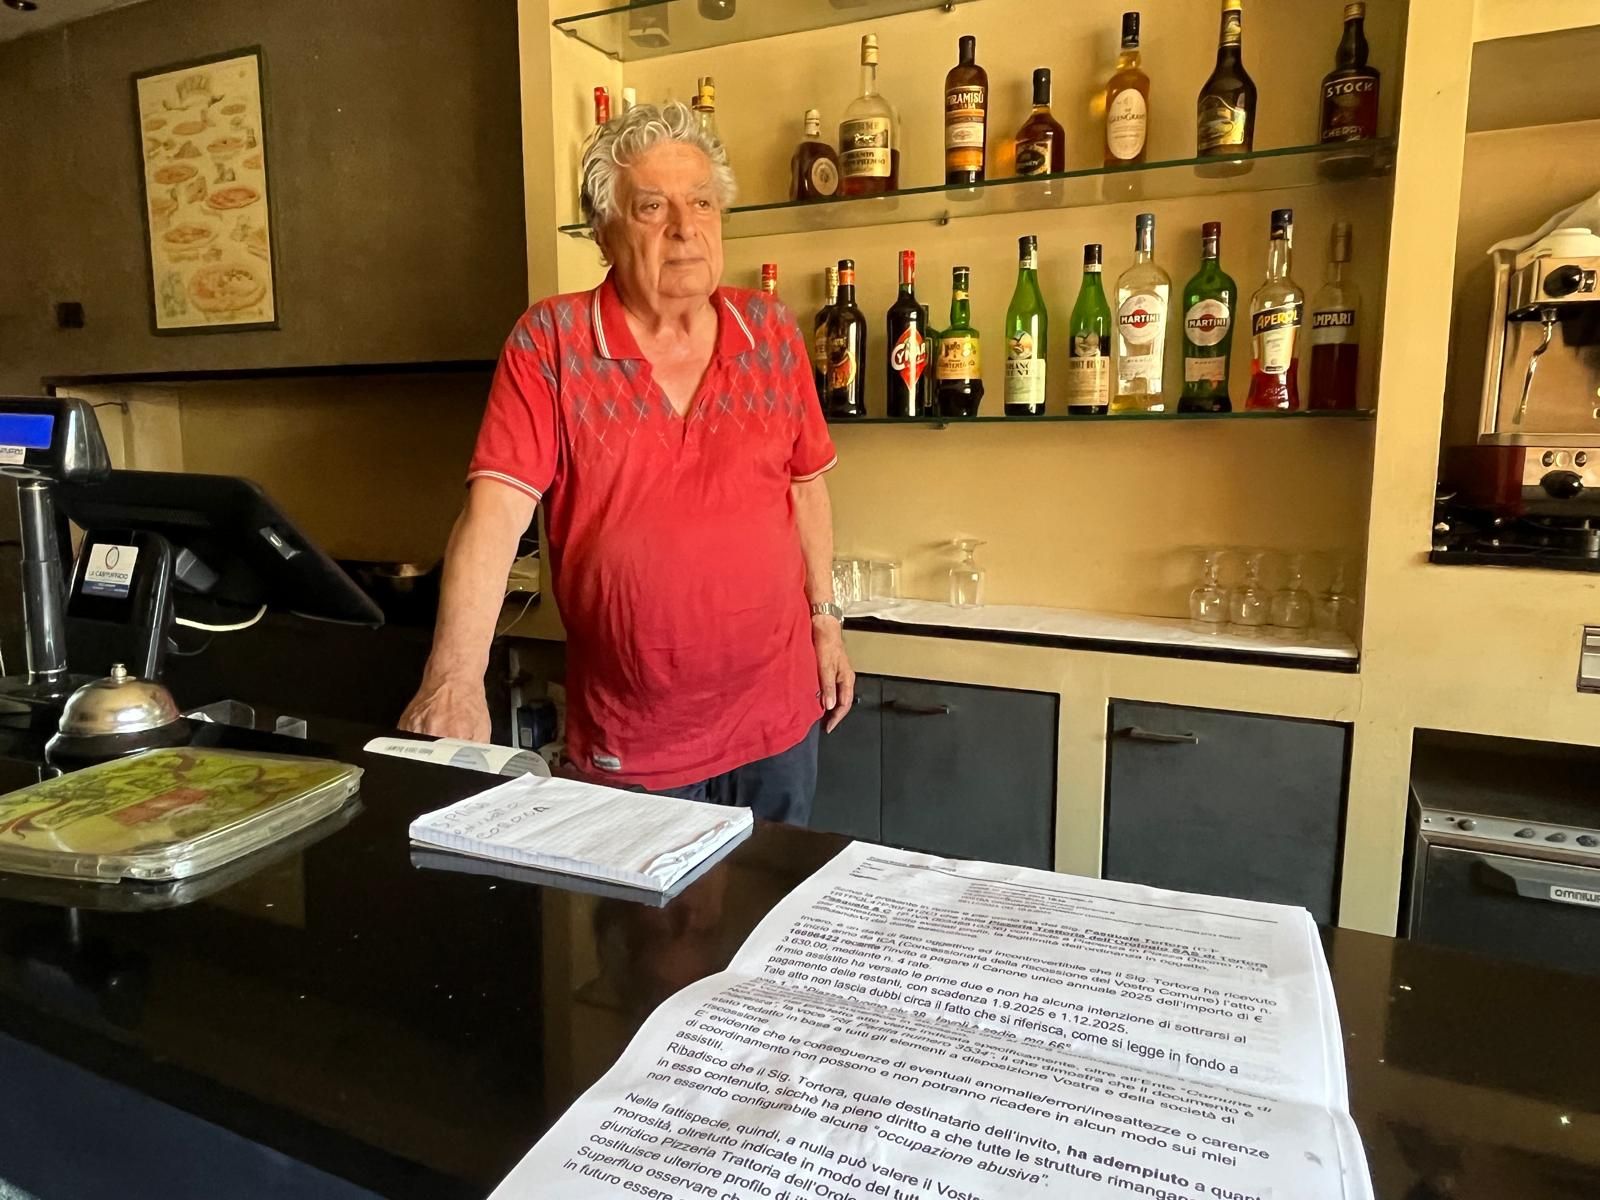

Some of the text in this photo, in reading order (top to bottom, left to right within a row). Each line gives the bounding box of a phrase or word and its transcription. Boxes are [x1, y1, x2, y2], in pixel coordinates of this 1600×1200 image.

[1326, 82, 1374, 98] STOCK
[1120, 313, 1160, 325] MARTINI
[1188, 318, 1227, 328] MARTINI
[1255, 309, 1298, 331] APEROL
[832, 946, 881, 960] mediante
[763, 965, 785, 976] Tale
[787, 971, 808, 981] atto
[810, 976, 831, 986] non
[833, 979, 866, 994] lascia
[869, 987, 901, 1001] dubbi
[904, 995, 931, 1008] circa
[934, 1000, 940, 1010] il
[943, 1002, 970, 1016] fatto
[973, 1009, 996, 1021] che
[999, 1014, 1010, 1025] si
[1013, 1017, 1067, 1039] riferisca,
[1071, 1030, 1108, 1046] come
[1111, 1038, 1123, 1049] si
[1126, 1040, 1165, 1059] legge
[1169, 1048, 1180, 1063] in
[1185, 1053, 1225, 1072] fondo
[1229, 1065, 1238, 1074] a
[767, 956, 827, 972] pagamento
[830, 966, 856, 978] delle
[906, 983, 927, 993] con
[930, 987, 987, 1005] scadenza
[992, 998, 1044, 1016] 1.9.2025
[1048, 1011, 1056, 1019] e
[1061, 1013, 1128, 1034] 1.12.2025.
[783, 947, 803, 955] mio
[804, 951, 848, 964] assistito
[850, 958, 865, 967] ha
[868, 963, 908, 976] versato
[911, 970, 922, 979] le
[924, 974, 957, 986] prime
[960, 981, 983, 991] due
[996, 988, 1019, 998] non
[1022, 992, 1039, 1002] ha
[1041, 998, 1084, 1012] alcuna
[1087, 1005, 1154, 1026] intenzione
[1158, 1020, 1170, 1029] di
[1174, 1024, 1230, 1041] sottrarsi
[1234, 1035, 1246, 1044] al
[675, 1031, 723, 1051] assistiti.
[646, 1072, 671, 1082] non
[673, 1078, 728, 1098] essendo
[731, 1094, 817, 1119] configurabile
[820, 1115, 868, 1133] alcuna
[666, 1041, 727, 1067] Ribadisco
[730, 1062, 754, 1073] che
[756, 1067, 765, 1076] il
[766, 1069, 791, 1083] Sig.
[798, 1075, 847, 1099] Tortora,
[852, 1092, 891, 1106] quale
[895, 1100, 980, 1132] destinatario
[1066, 1145, 1087, 1160] ha
[1092, 1155, 1189, 1187] adempiuto
[1194, 1182, 1205, 1192] a
[684, 1019, 697, 1027] di
[699, 1024, 790, 1055] coordinamento
[792, 1048, 816, 1061] non
[818, 1056, 877, 1073] possono
[892, 1073, 919, 1084] non
[921, 1080, 986, 1101] potranno
[990, 1096, 1050, 1118] ricadere
[1055, 1111, 1068, 1123] in
[1073, 1118, 1116, 1135] alcun
[1120, 1131, 1167, 1148] modo
[1171, 1144, 1196, 1156] sui
[1201, 1151, 1236, 1167] miei
[709, 1015, 760, 1033] evidente
[762, 1030, 785, 1041] che
[788, 1035, 800, 1045] le
[803, 1040, 890, 1065] conseguenze
[892, 1061, 906, 1069] di
[909, 1065, 971, 1084] eventuali
[974, 1080, 1181, 1137] anomalie/errori/inesattezze
[1186, 1133, 1197, 1141] o
[1201, 1136, 1270, 1159] carenze
[599, 1120, 658, 1143] giuridico
[660, 1137, 716, 1158] Pizzeria
[721, 1150, 780, 1180] Trattoria
[624, 1092, 659, 1109] Nella
[660, 1103, 730, 1131] fattispecie,
[736, 1125, 780, 1143] quindi,
[785, 1137, 796, 1146] a
[799, 1141, 834, 1160] nulla
[837, 1154, 866, 1169] può
[871, 1163, 918, 1186] valere
[922, 1178, 932, 1191] il
[656, 1057, 669, 1068] in
[671, 1063, 702, 1075] esso
[704, 1071, 770, 1094] contenuto,
[820, 1098, 838, 1111] ha
[842, 1105, 882, 1119] pieno
[886, 1114, 926, 1134] diritto
[930, 1129, 940, 1139] a
[944, 1133, 972, 1148] che
[976, 1139, 1010, 1158] tutte
[1015, 1149, 1030, 1162] le
[1034, 1157, 1102, 1182] strutture
[562, 1158, 578, 1171] in
[579, 1164, 620, 1185] futuro
[576, 1146, 644, 1173] Superfluo
[645, 1168, 718, 1198] osservare
[589, 1134, 660, 1160] costituisce
[663, 1155, 722, 1178] ulteriore
[722, 1173, 771, 1197] profilo
[612, 1106, 671, 1133] morosità,
[676, 1122, 738, 1146] oltretutto
[740, 1139, 797, 1165] indicate
[800, 1157, 815, 1172] in
[817, 1166, 861, 1188] modo
[864, 1180, 889, 1197] del
